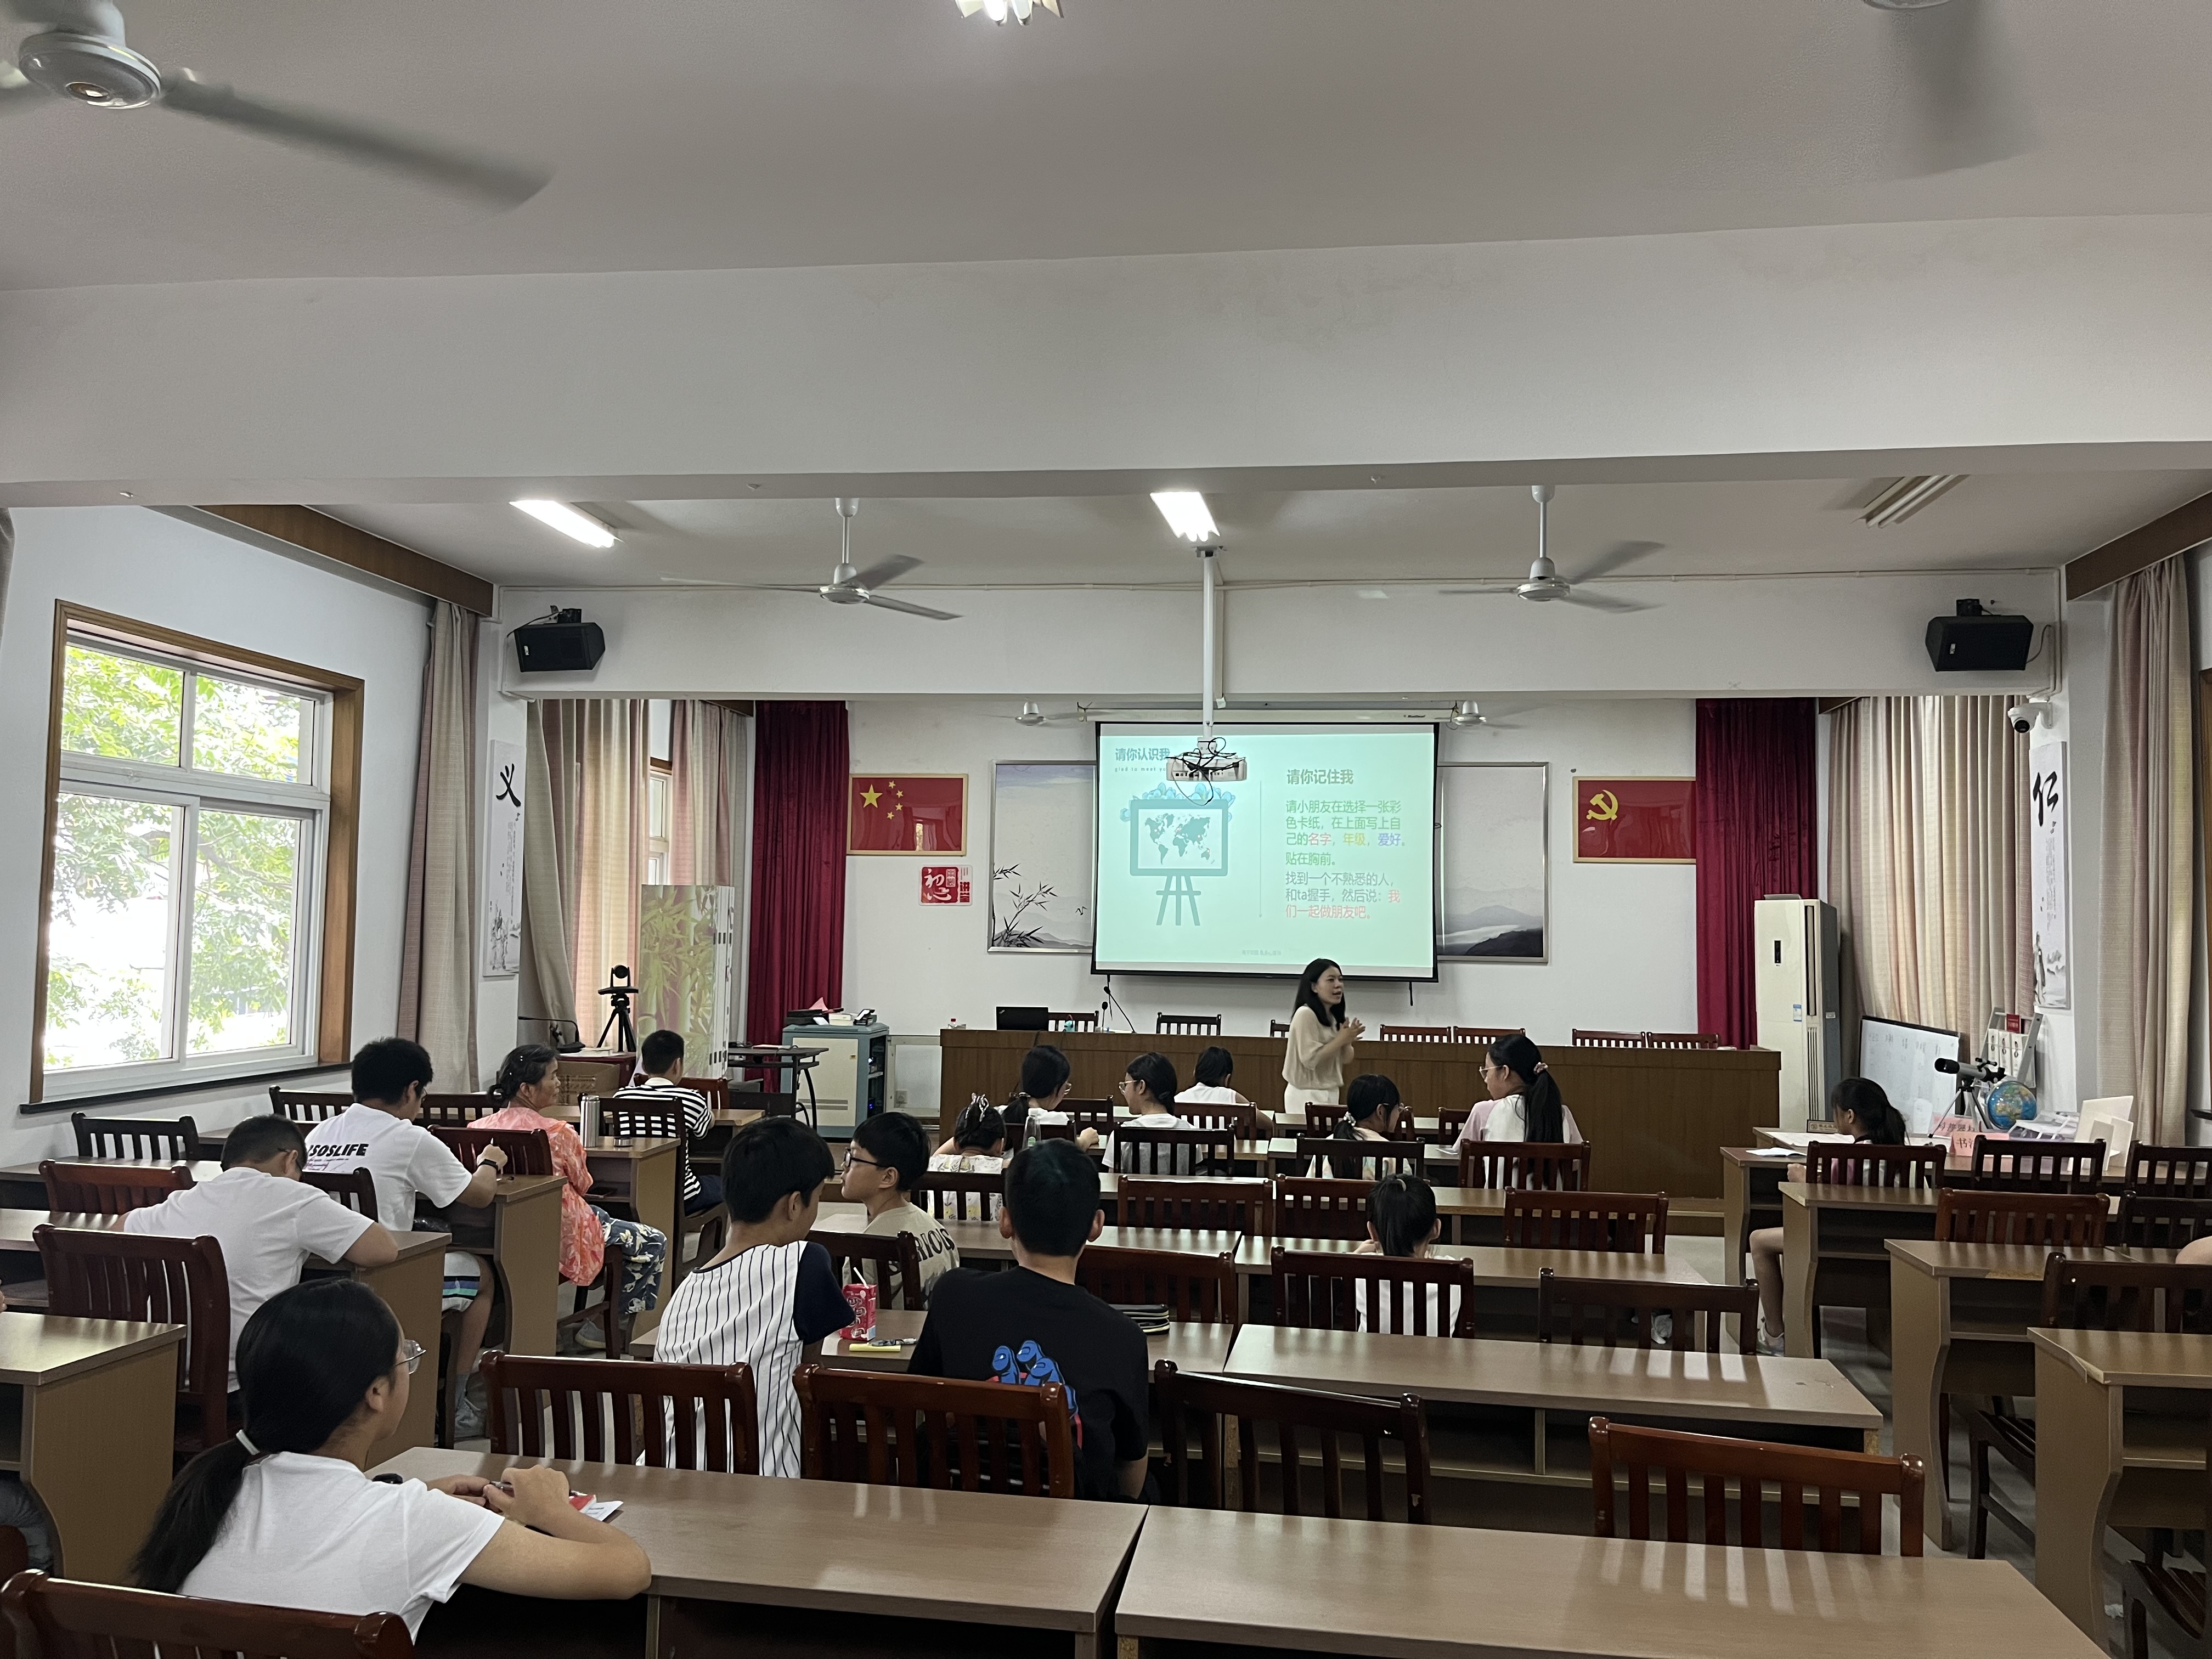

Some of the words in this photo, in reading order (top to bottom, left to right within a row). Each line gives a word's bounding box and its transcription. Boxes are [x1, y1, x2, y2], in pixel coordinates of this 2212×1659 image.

[1115, 748, 1170, 761] 请你认识我
[1286, 769, 1354, 785] 请你记住我
[496, 763, 521, 808] 义
[1285, 799, 1401, 814] 请小朋友在选择一张彩
